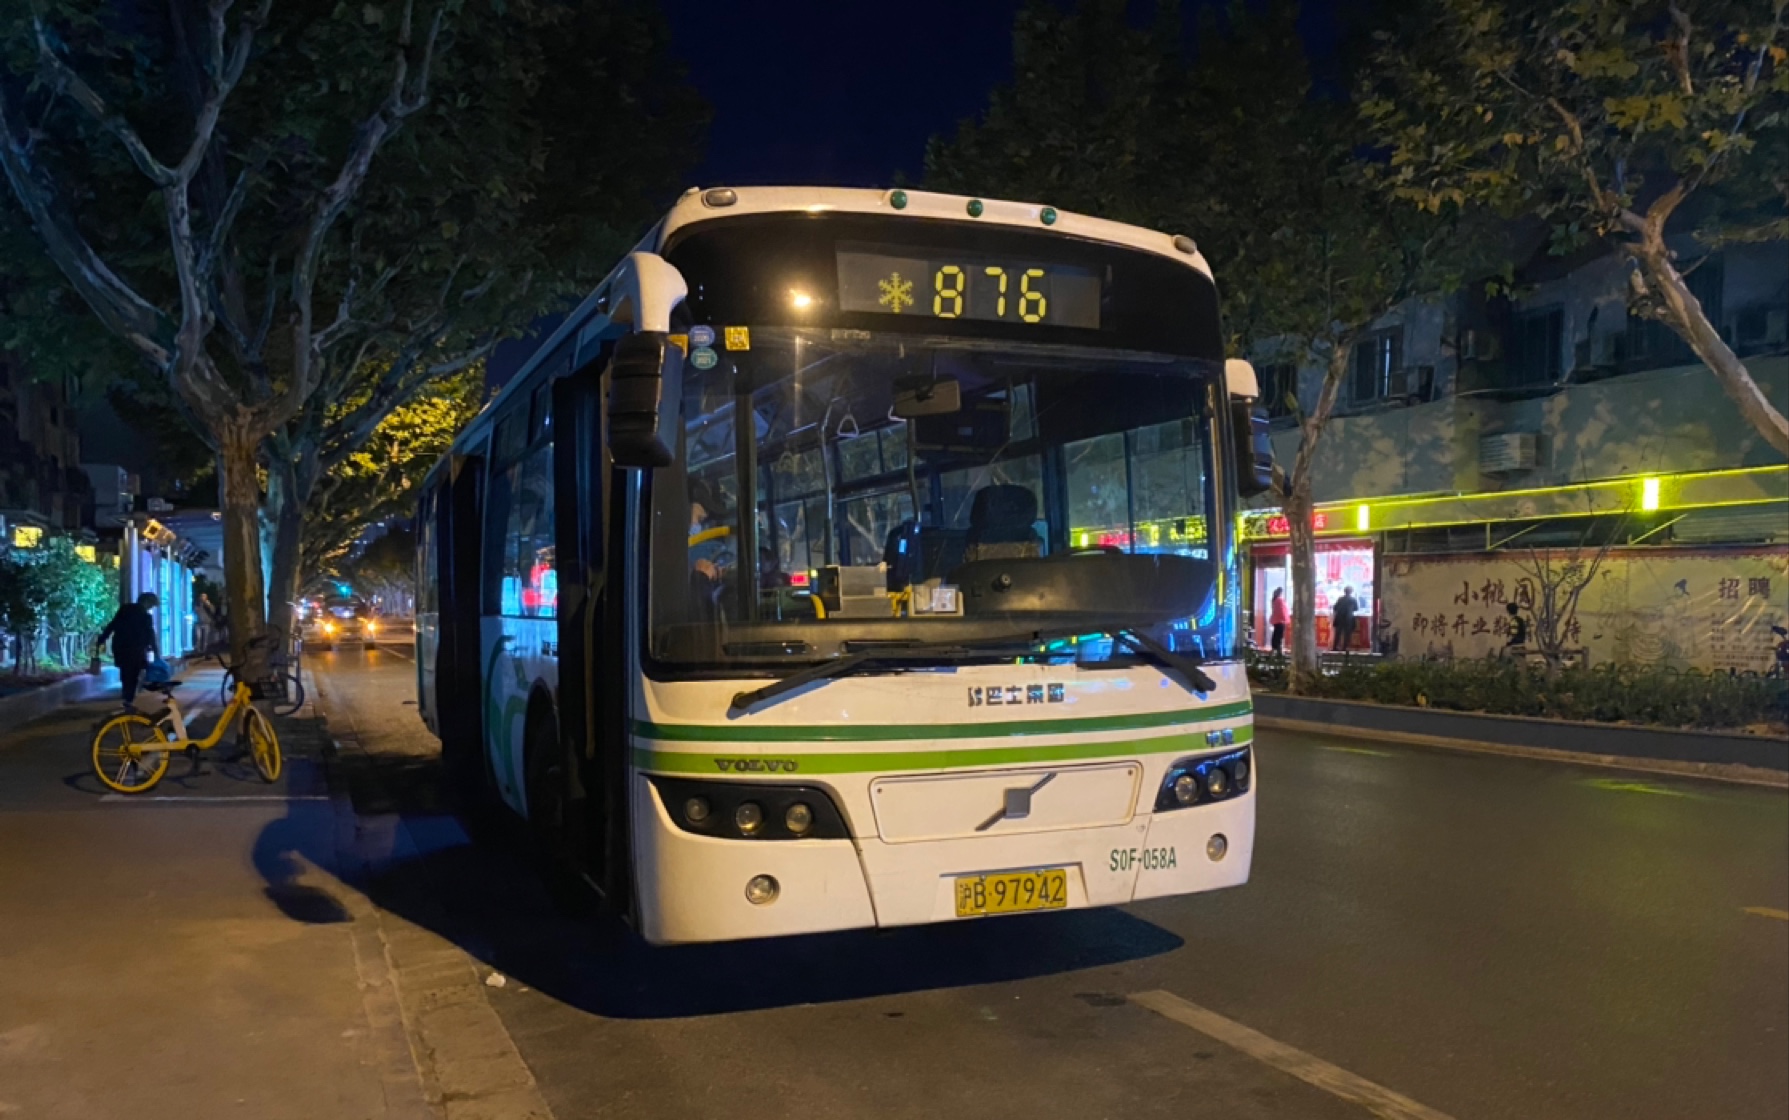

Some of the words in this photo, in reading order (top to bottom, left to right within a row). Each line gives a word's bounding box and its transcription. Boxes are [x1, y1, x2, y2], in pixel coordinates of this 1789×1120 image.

[933, 265, 1047, 323] 876
[1454, 577, 1535, 611] 小桃园
[1719, 576, 1770, 599] 招聘
[714, 758, 799, 772] VOLVO
